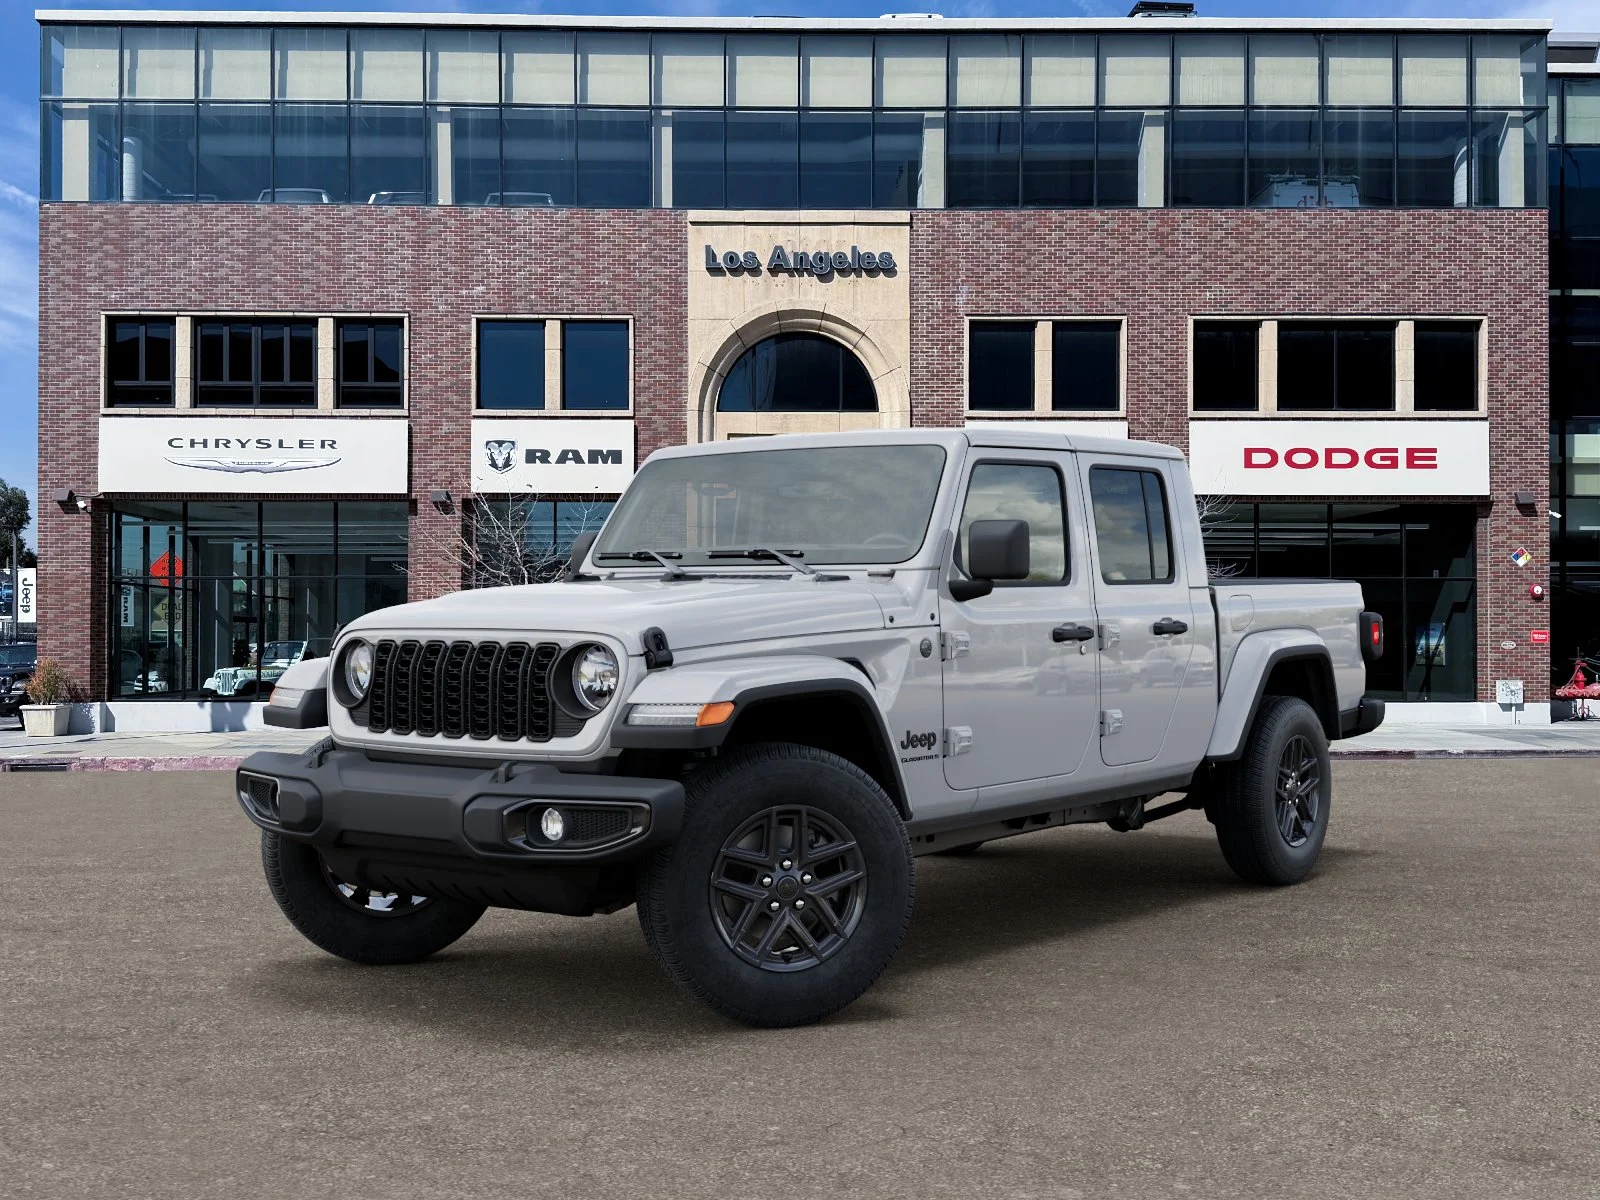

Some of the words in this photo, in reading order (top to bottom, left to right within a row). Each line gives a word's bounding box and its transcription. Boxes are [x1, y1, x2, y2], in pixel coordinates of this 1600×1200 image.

[1297, 195, 1333, 207] dih
[705, 244, 758, 269] Los
[767, 244, 894, 275] Angeles
[167, 438, 338, 449] CHRYSLER
[525, 449, 622, 464] RAM
[1244, 447, 1437, 469] DODGE
[20, 578, 33, 613] Jeep
[901, 730, 936, 750] Jeep
[901, 755, 934, 763] GLADIATOR
